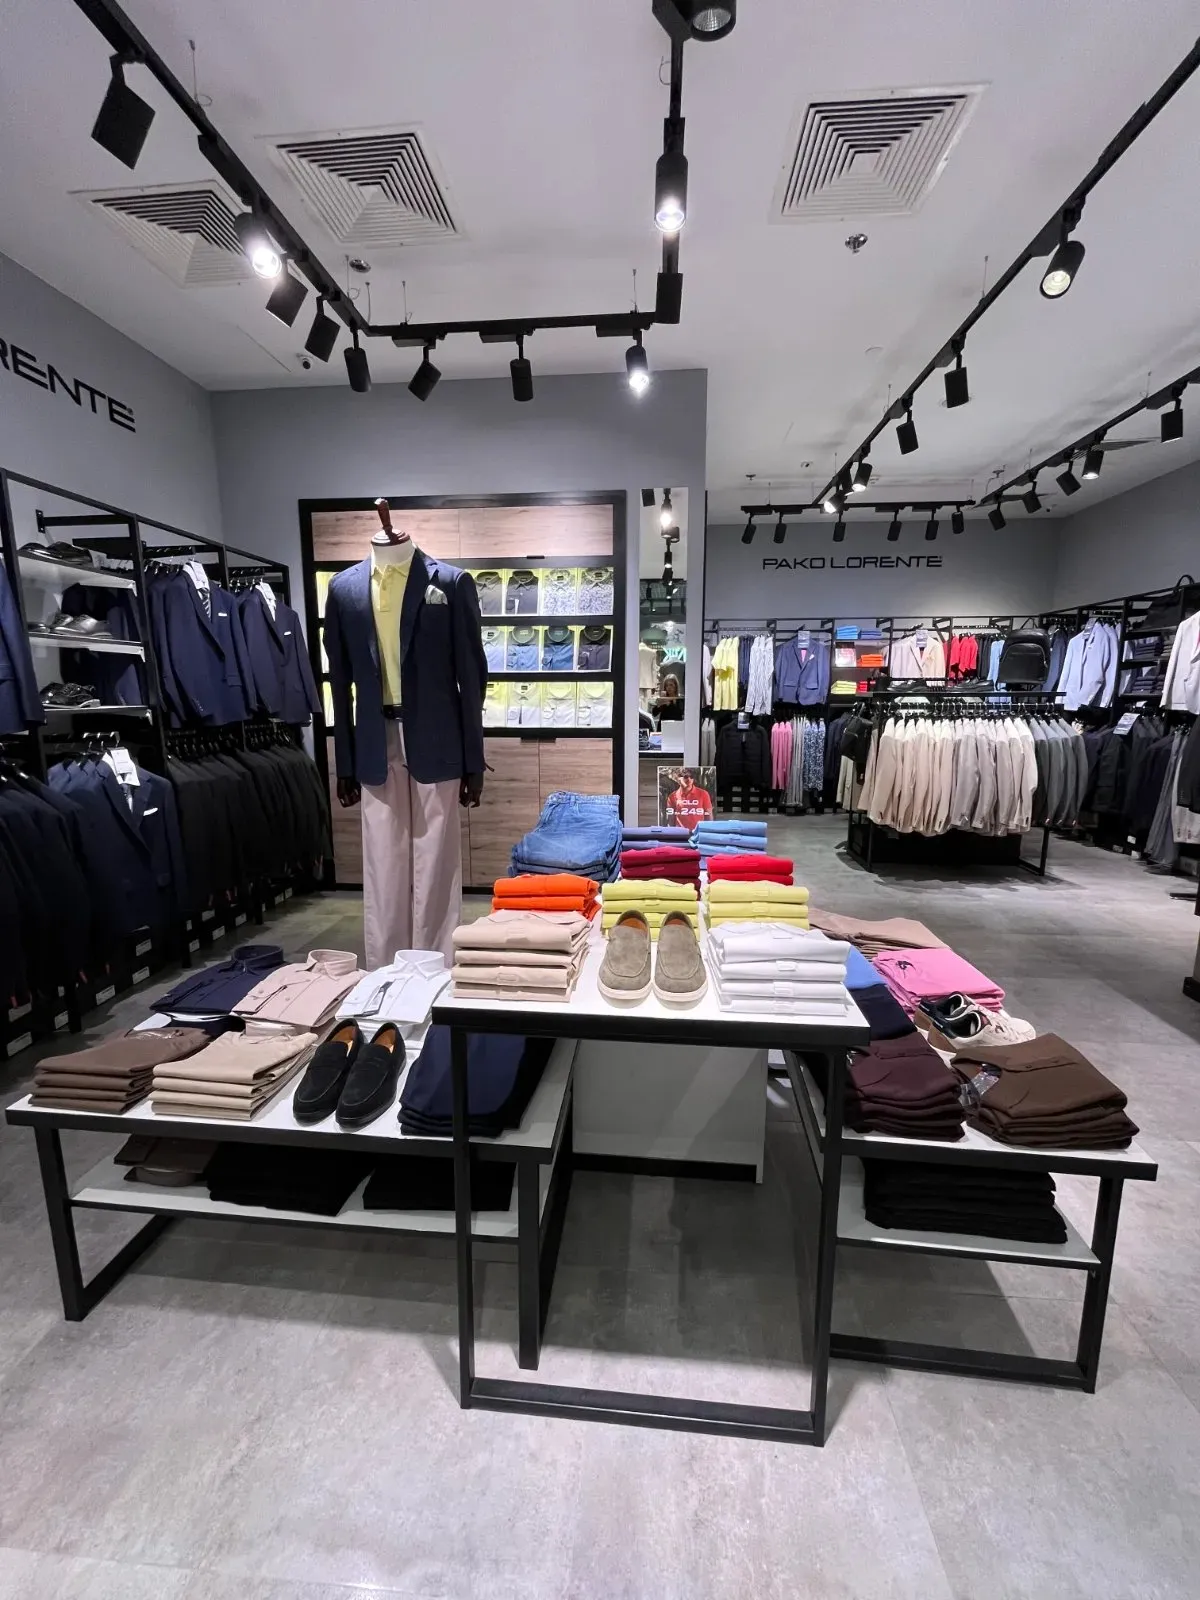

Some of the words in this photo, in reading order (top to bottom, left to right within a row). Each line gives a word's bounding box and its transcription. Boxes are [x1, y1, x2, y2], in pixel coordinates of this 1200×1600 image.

[0, 337, 136, 433] ENTE
[763, 557, 826, 570] PAKO
[830, 555, 942, 569] LORENTE
[665, 807, 674, 816] 3
[680, 807, 705, 816] 249
